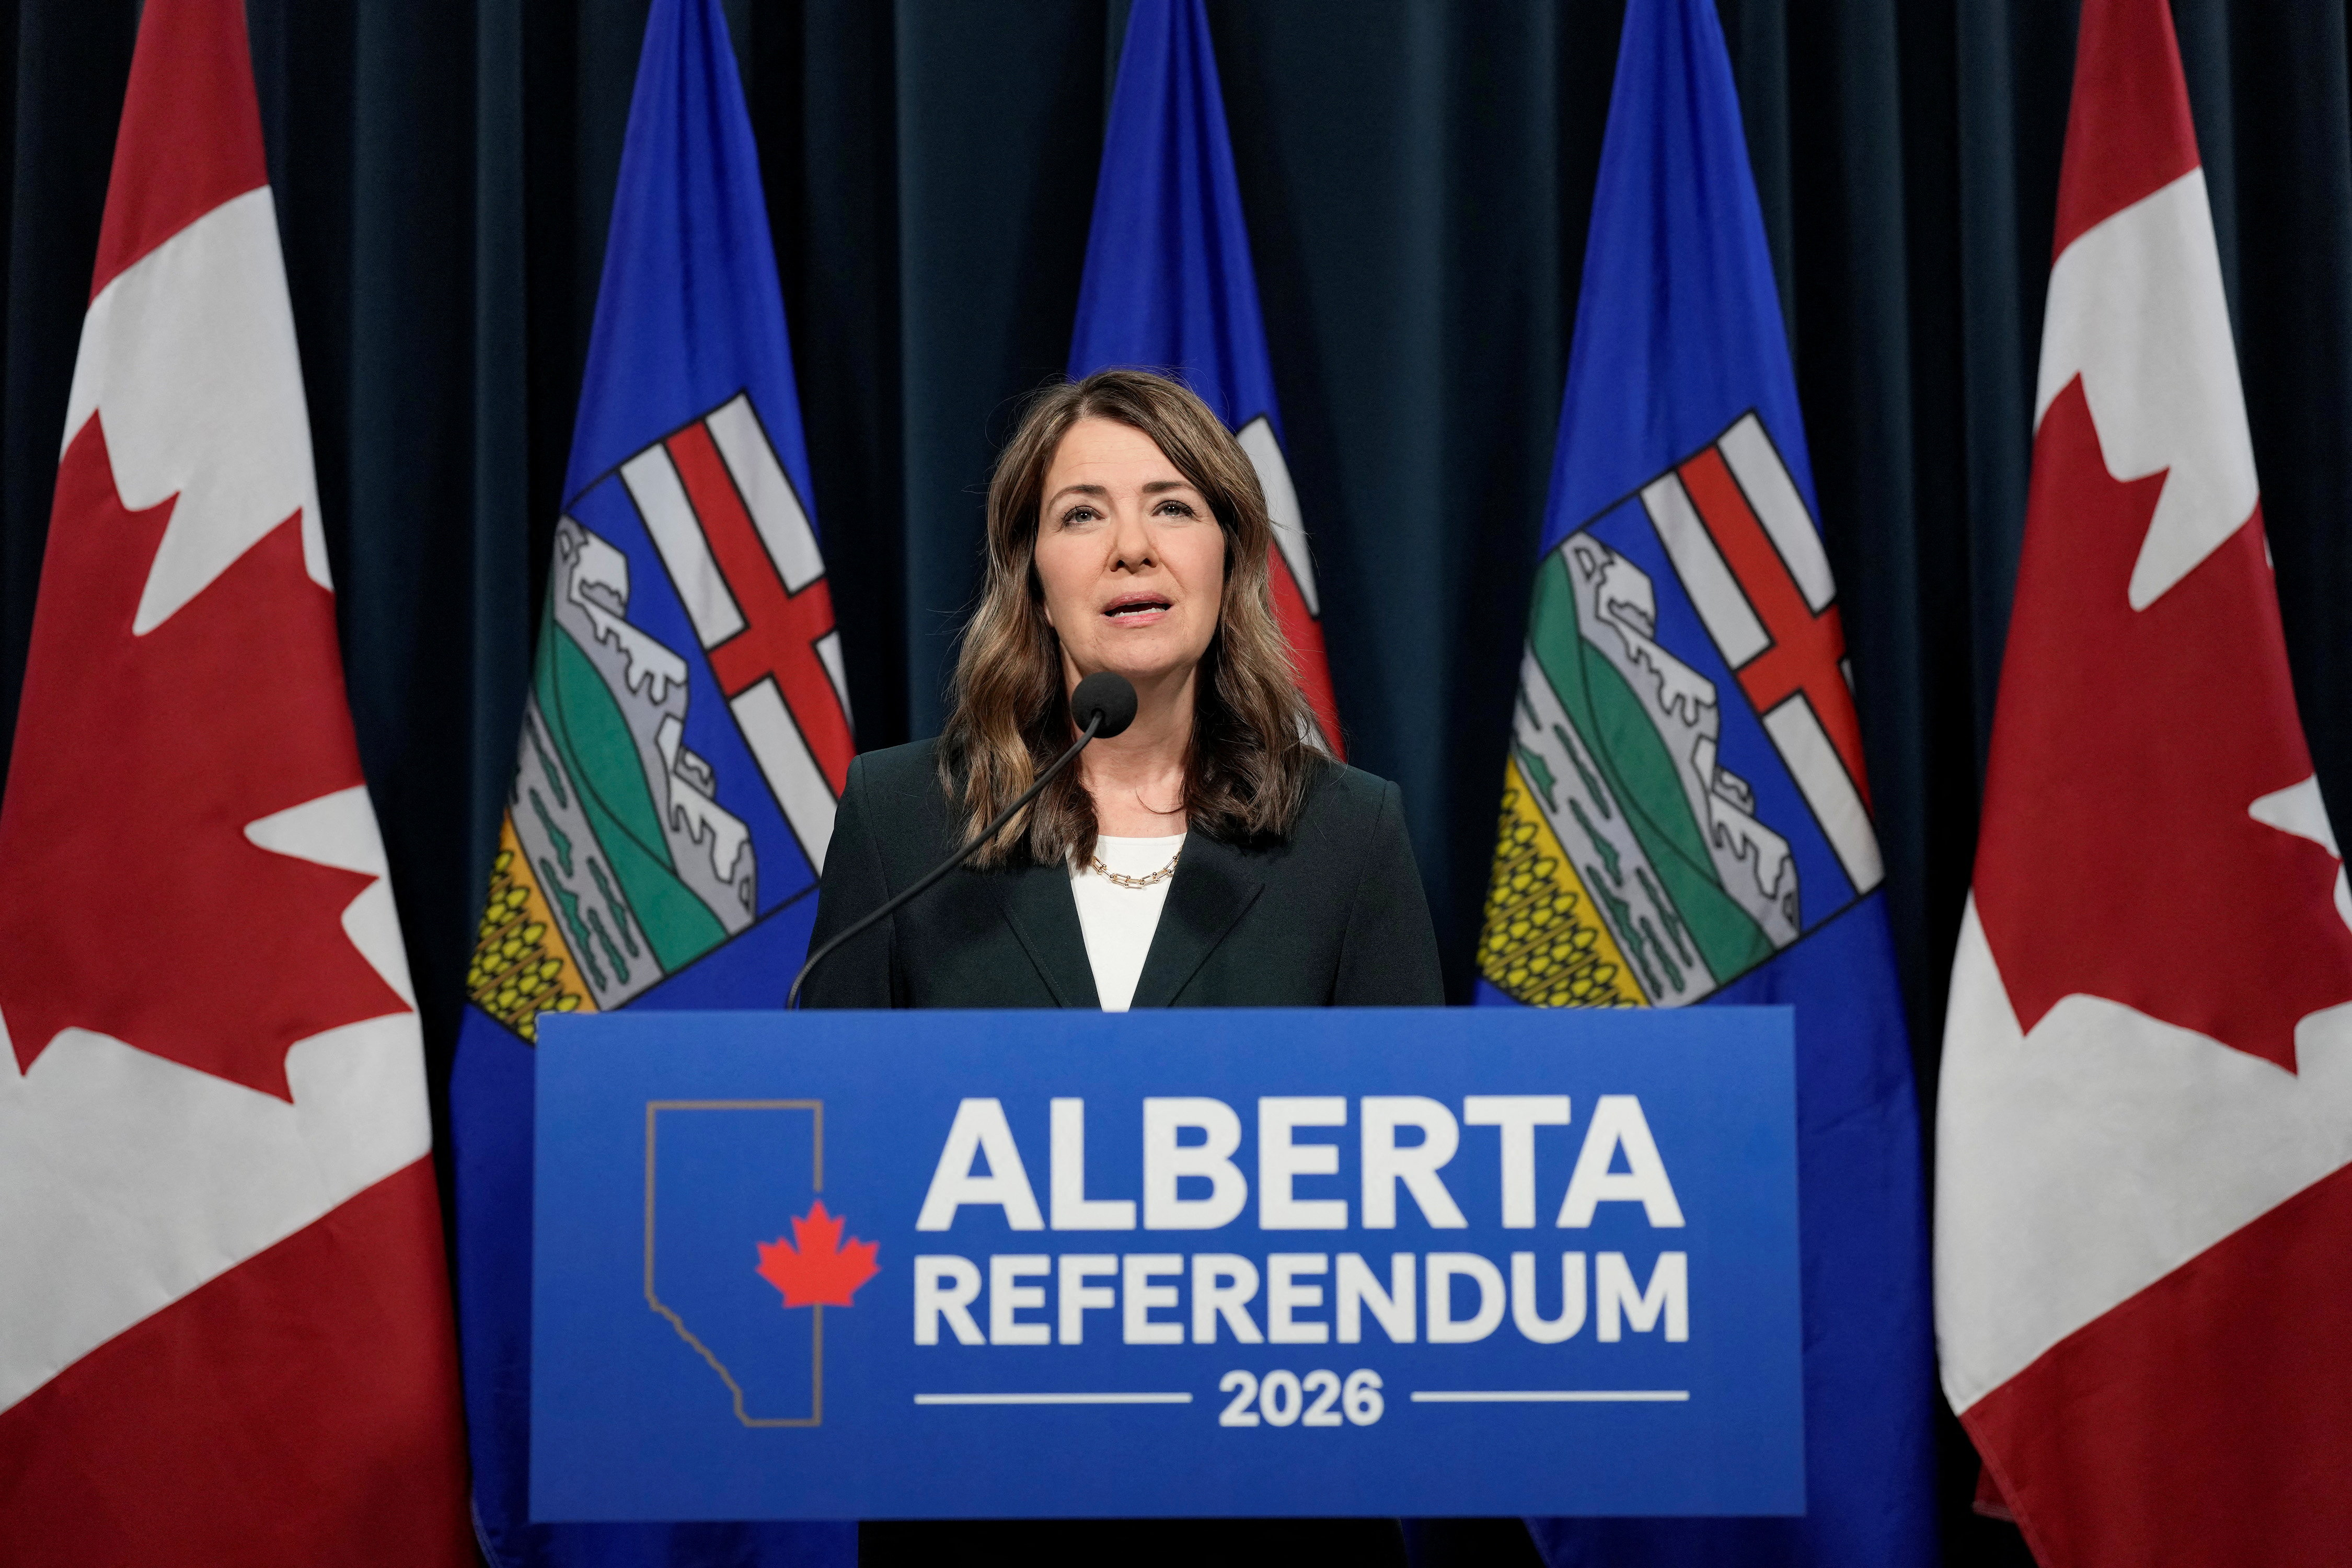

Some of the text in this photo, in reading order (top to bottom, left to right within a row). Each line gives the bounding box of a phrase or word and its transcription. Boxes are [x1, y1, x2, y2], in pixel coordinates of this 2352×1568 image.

[916, 1096, 1685, 1231] ALBERTA
[914, 1251, 1688, 1345] REFERENDUM
[1219, 1369, 1384, 1426] 2026
